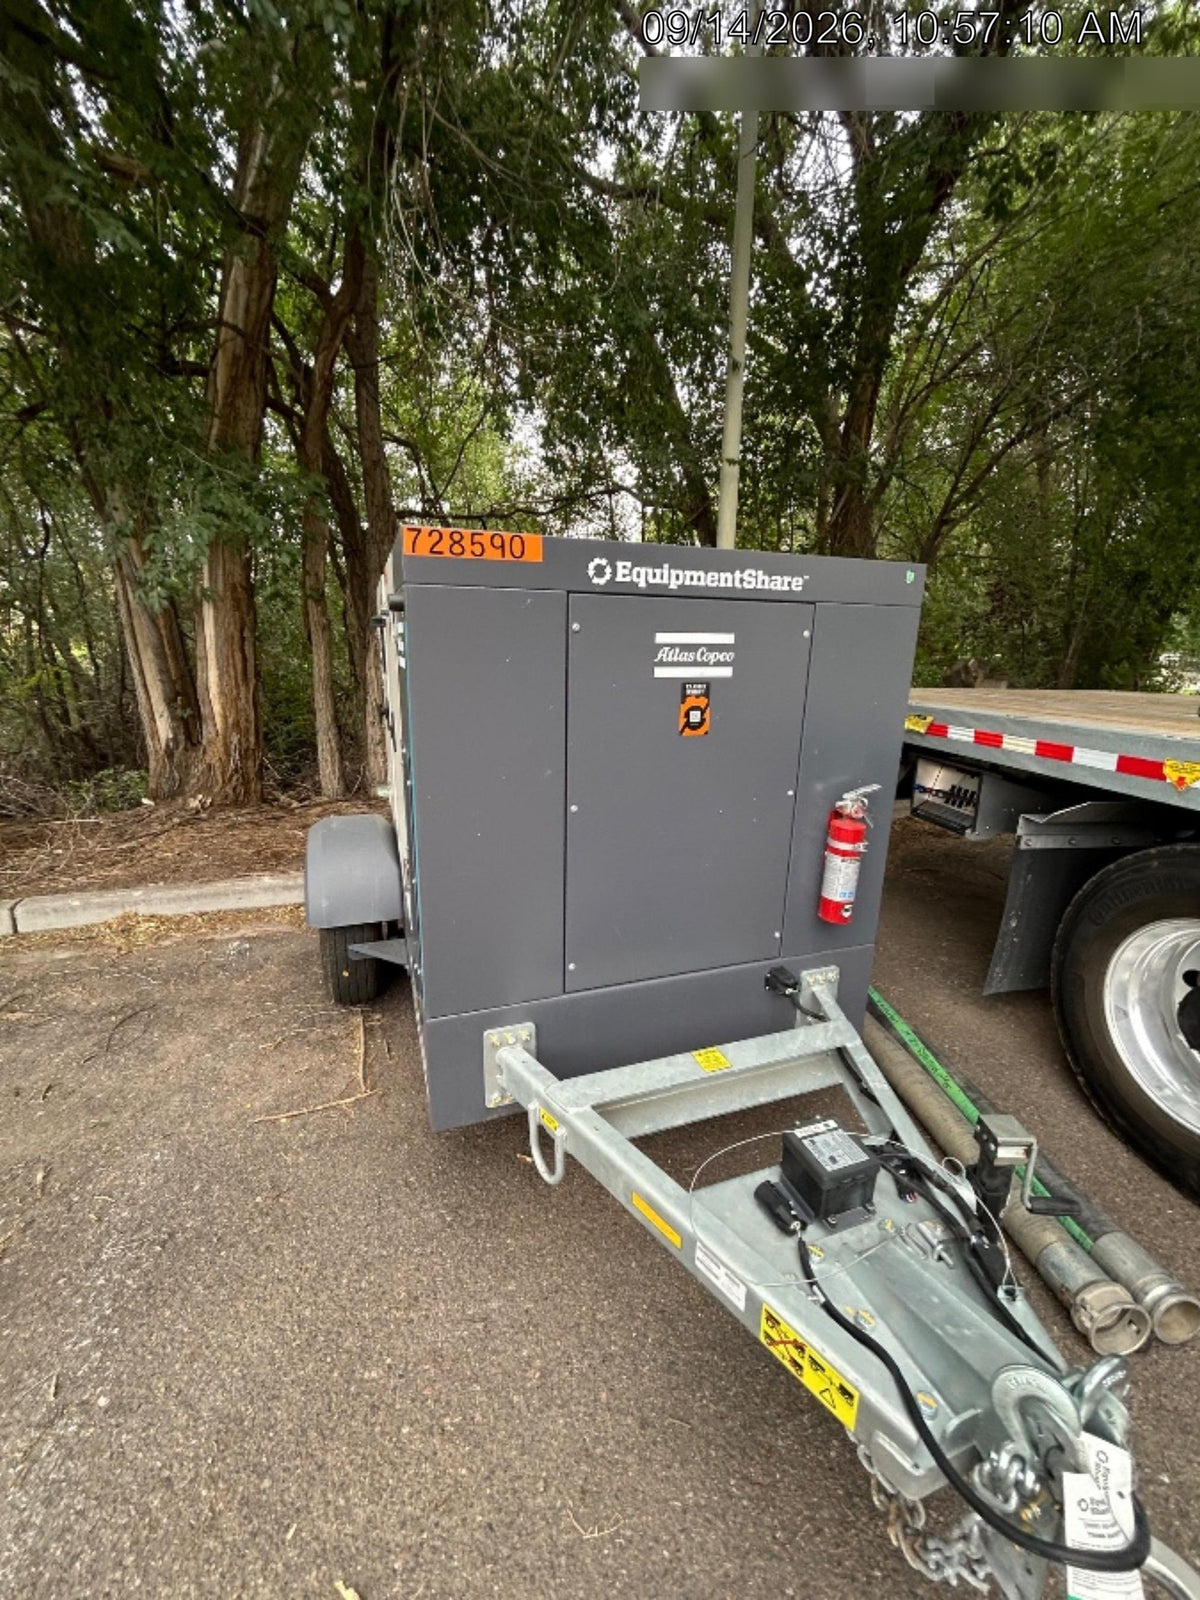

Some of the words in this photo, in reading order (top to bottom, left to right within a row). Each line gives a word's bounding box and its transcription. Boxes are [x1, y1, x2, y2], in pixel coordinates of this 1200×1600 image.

[406, 527, 525, 559] 728590
[615, 560, 804, 591] EquipmentShare
[654, 646, 696, 662] Atlas
[696, 646, 735, 665] Copco
